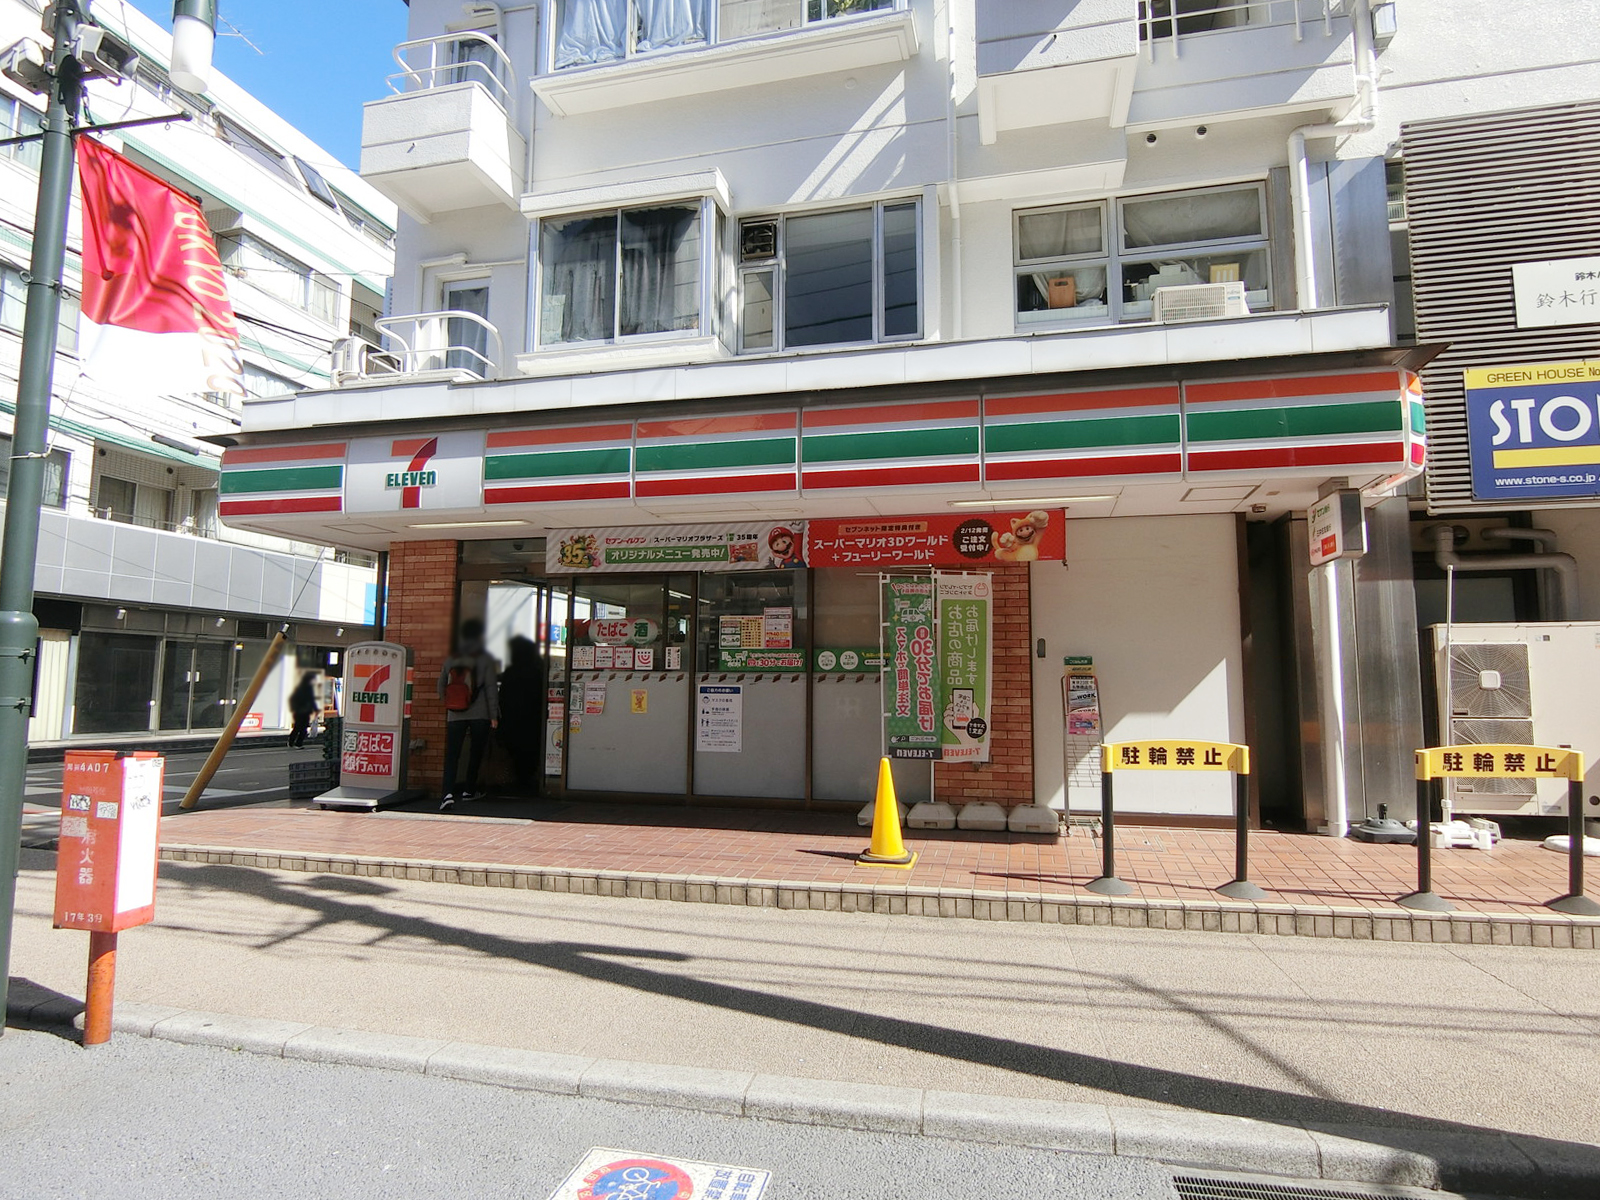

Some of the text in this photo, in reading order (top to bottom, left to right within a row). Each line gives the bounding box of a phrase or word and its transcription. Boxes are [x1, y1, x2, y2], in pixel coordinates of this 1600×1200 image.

[1575, 271, 1600, 281] 鈴木
[192, 302, 249, 398] 2020
[1487, 371, 1532, 384] GREEN
[1536, 367, 1585, 380] HOUSE
[1489, 393, 1600, 446] STO
[391, 436, 438, 509] 7
[1495, 472, 1596, 486] www.stone-s.co.jp
[813, 534, 949, 550] スーパーマリオ3Dワールド
[962, 535, 987, 544] ご注文
[597, 622, 649, 637] たばこ 酒
[354, 664, 391, 722] 7
[344, 732, 392, 752] 酒 たばこ
[1121, 745, 1222, 766] 駐輪禁止
[1442, 752, 1557, 773] 駐輪禁止
[79, 829, 97, 885] 消火器
[702, 1169, 733, 1200] 放置禁
